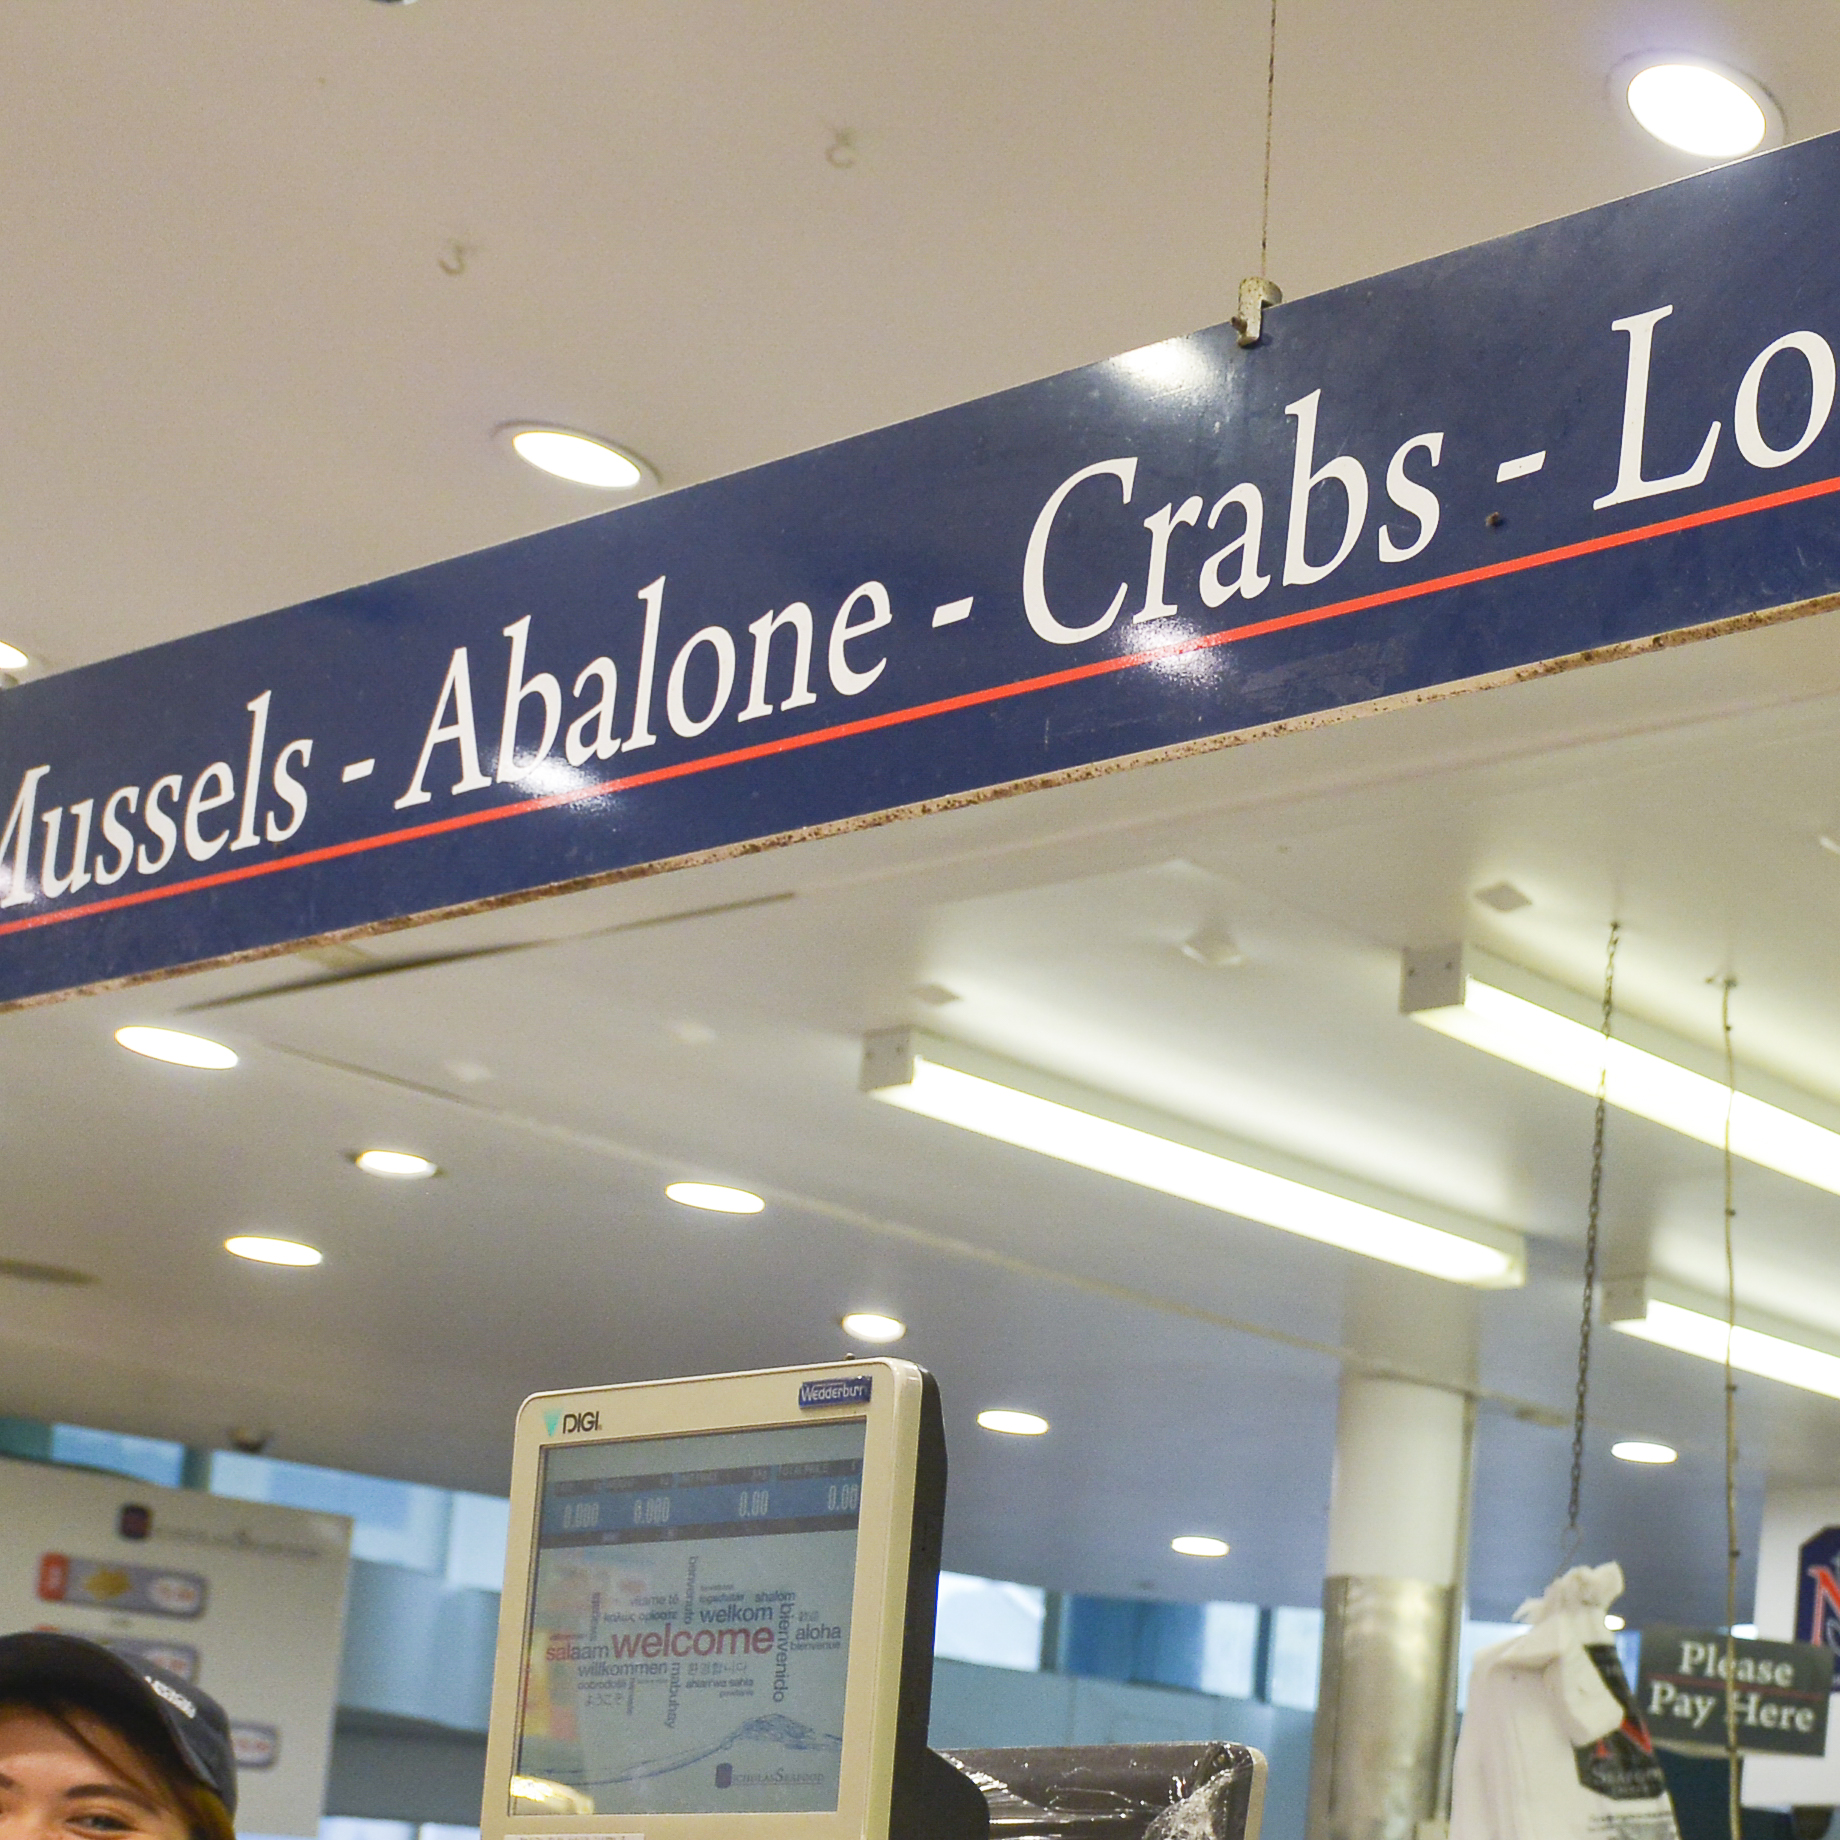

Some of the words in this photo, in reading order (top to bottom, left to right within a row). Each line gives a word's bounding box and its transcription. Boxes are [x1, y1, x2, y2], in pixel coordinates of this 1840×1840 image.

[394, 576, 895, 812] Abalone
[1022, 388, 1443, 646] Crabs
[563, 1411, 599, 1434] DIGI
[700, 1604, 773, 1624] welkom
[611, 1623, 775, 1660] welcome
[795, 1623, 842, 1642] aloha
[545, 1644, 609, 1662] salaam
[772, 1602, 796, 1703] bienvenido
[1678, 1640, 1795, 1689] Please
[577, 1660, 668, 1678] willkommen
[1647, 1680, 1716, 1729] Pay
[1726, 1691, 1816, 1735] Here
